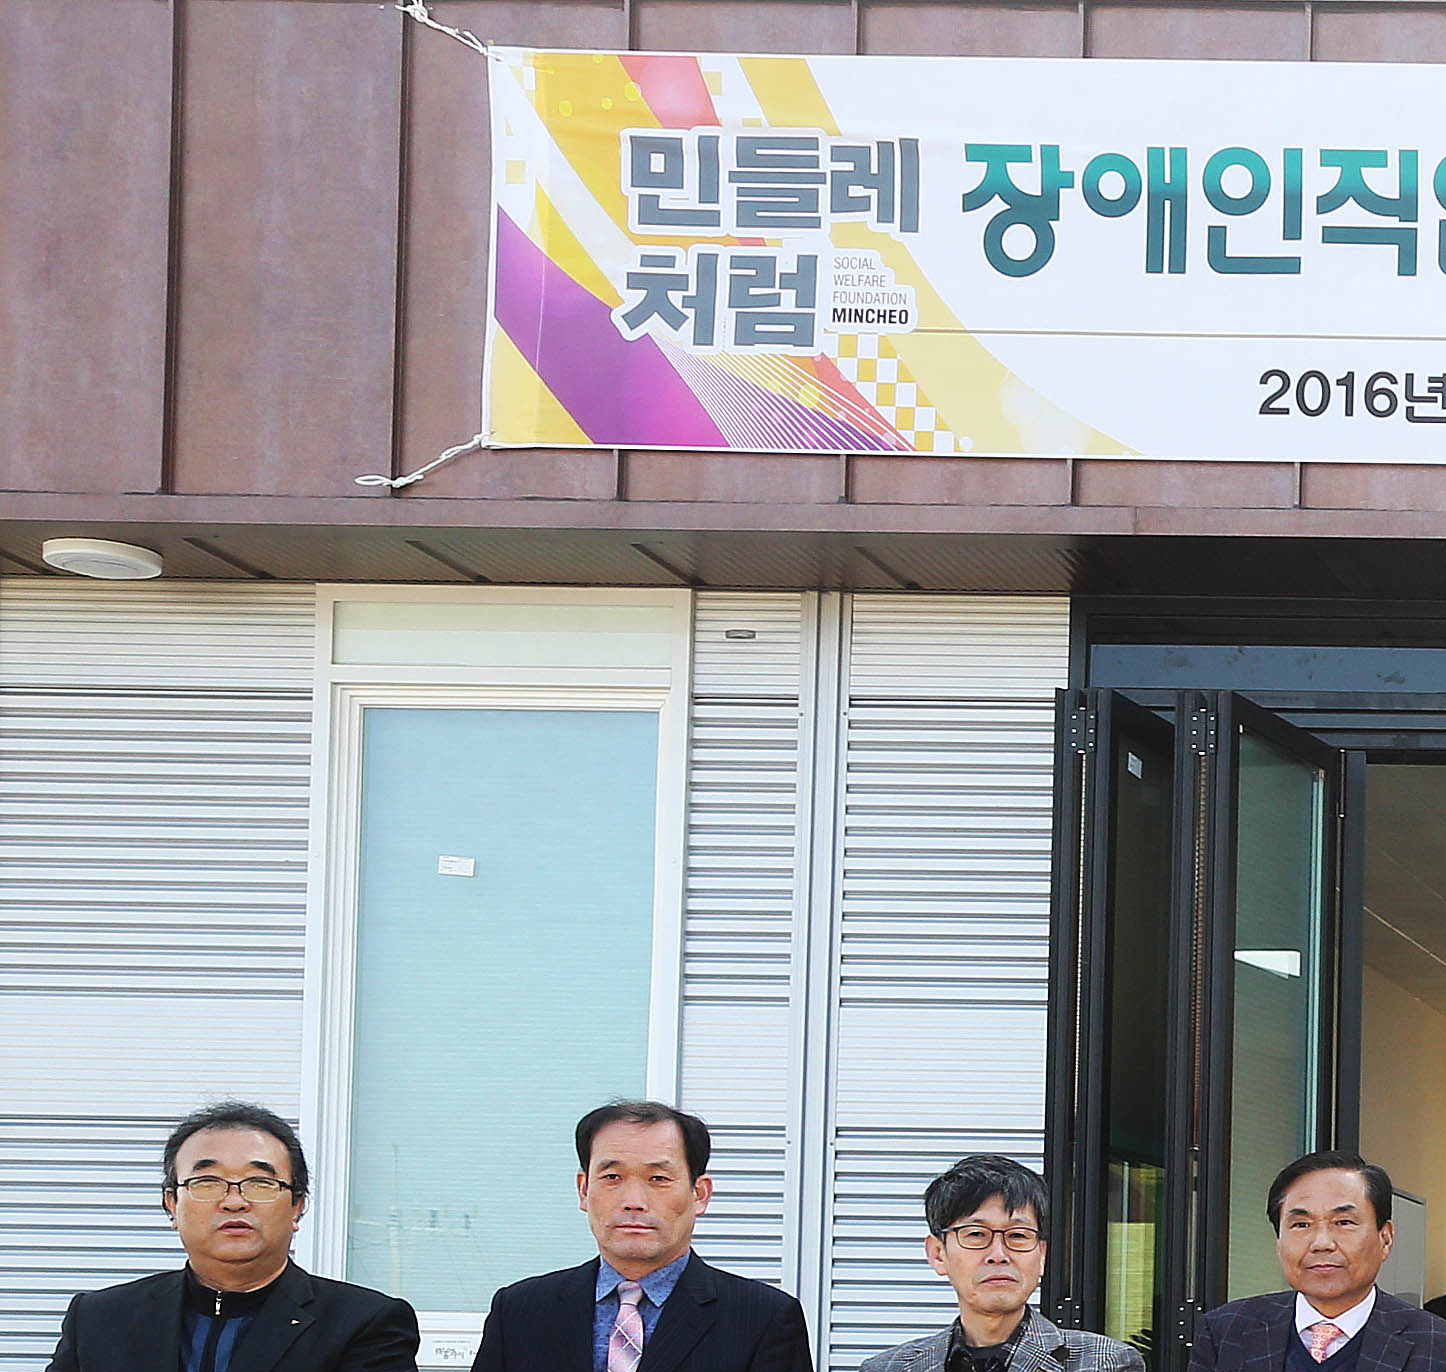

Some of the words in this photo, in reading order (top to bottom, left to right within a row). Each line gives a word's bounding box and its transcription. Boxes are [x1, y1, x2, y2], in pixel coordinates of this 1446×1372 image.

[629, 134, 919, 233] 민들레
[833, 256, 876, 270] SOCIAL
[833, 274, 887, 288] WELFARE
[621, 252, 818, 347] 처럼
[832, 291, 907, 305] FOUNDATION
[832, 308, 909, 325] MINCHEO
